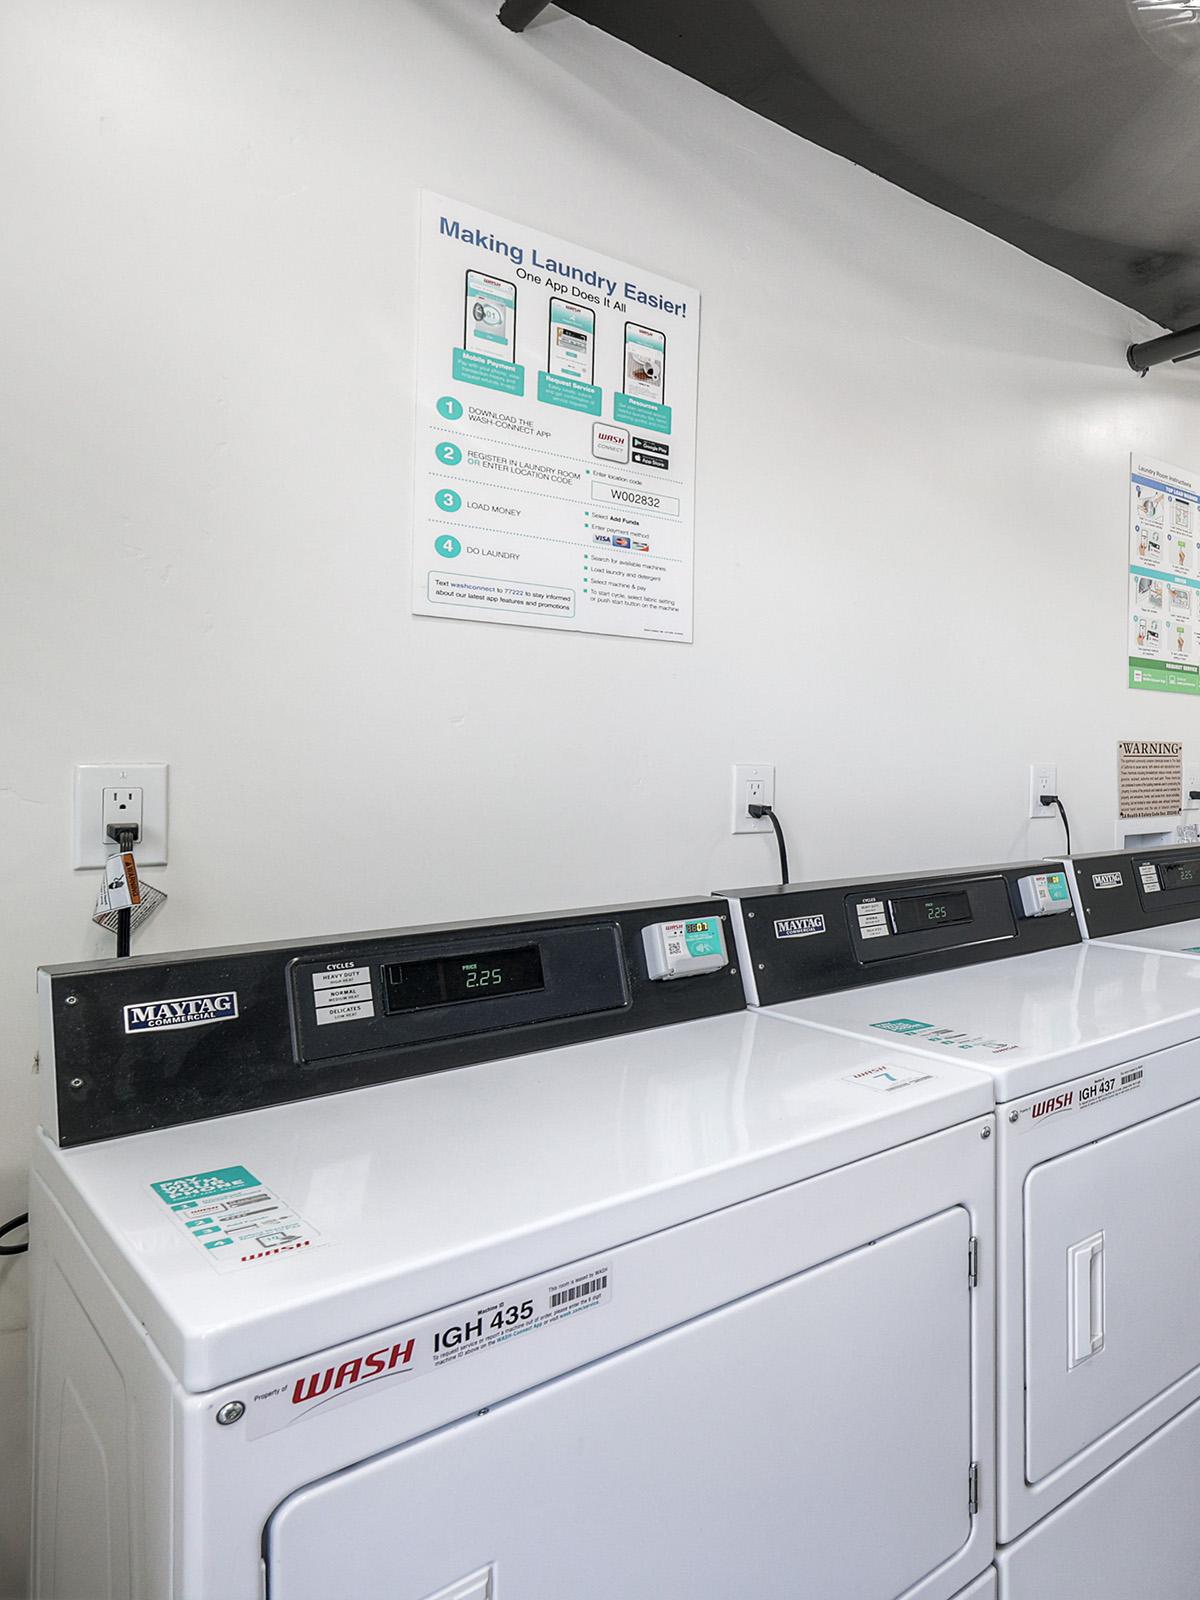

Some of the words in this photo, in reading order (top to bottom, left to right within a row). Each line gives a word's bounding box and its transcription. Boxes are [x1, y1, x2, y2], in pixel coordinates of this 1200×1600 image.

[440, 216, 523, 265] Making
[532, 249, 617, 296] Laundry
[624, 282, 687, 318] Easier!
[516, 268, 541, 284] One
[545, 278, 568, 295] App
[572, 286, 600, 304] Does
[604, 297, 610, 308] It
[613, 301, 626, 313] All
[462, 352, 485, 364] Mobile
[487, 358, 516, 373] Payment
[545, 374, 571, 389] Request
[572, 382, 595, 394] Service
[446, 401, 453, 414] 1
[629, 398, 658, 411] Resources
[468, 406, 517, 424] DOWNLOAD
[519, 419, 533, 427] THE
[468, 414, 534, 435] WASH-CONNECT
[536, 430, 551, 439] APP
[598, 432, 624, 445] WASH
[443, 447, 454, 459] 2
[597, 443, 623, 453] CONNECT
[467, 450, 507, 464] REGISTER
[509, 458, 518, 467] IN
[519, 461, 556, 474] LAUNDRY
[557, 469, 580, 480] ROOM
[468, 458, 480, 466] OR
[482, 462, 509, 473] ENTER
[510, 467, 549, 480] LOCATION
[551, 475, 573, 485] CODE
[593, 470, 606, 478] Enter
[608, 473, 628, 482] location
[443, 493, 453, 506] 3
[611, 489, 660, 508] W002832
[467, 501, 490, 512] LOAD
[492, 506, 521, 517] MONEY
[592, 512, 608, 520] Select
[622, 518, 640, 526] Funds
[595, 534, 611, 542] VISA
[606, 527, 629, 536] payment
[443, 539, 453, 552] 4
[466, 547, 480, 555] DO
[482, 549, 520, 560] LAUNDRY
[435, 579, 449, 587] Text
[450, 582, 496, 592] washconnect
[504, 588, 523, 596] 77222
[532, 592, 544, 600] stay
[546, 594, 570, 602] informed
[500, 597, 524, 605] features
[538, 601, 570, 610] promotions
[1123, 743, 1178, 754] WARNING
[1094, 873, 1120, 885] MAYTAG
[778, 917, 822, 932] MAYTAG
[326, 961, 355, 971] CYCLES
[466, 968, 502, 988] 2.25
[331, 989, 356, 997] NORMAL
[131, 996, 232, 1023] MAYTAG
[329, 1006, 361, 1015] DELICATES
[147, 1011, 215, 1027] COMMERCIAL
[873, 1073, 896, 1081] 7
[1031, 1091, 1073, 1118] WASH
[1079, 1085, 1097, 1101] IGH
[1099, 1078, 1116, 1094] 437
[241, 1240, 310, 1262] WASH
[477, 1305, 498, 1316] Machine
[440, 1347, 459, 1358] request
[460, 1341, 478, 1350] service
[485, 1333, 500, 1341] report
[505, 1323, 525, 1334] machine
[254, 1388, 280, 1402] Property
[281, 1384, 288, 1393] of
[291, 1338, 416, 1404] WASH
[434, 1318, 482, 1352] IGH
[490, 1300, 533, 1329] 435
[435, 1354, 456, 1366] machine
[464, 1345, 479, 1355] above
[497, 1333, 512, 1342] WASH
